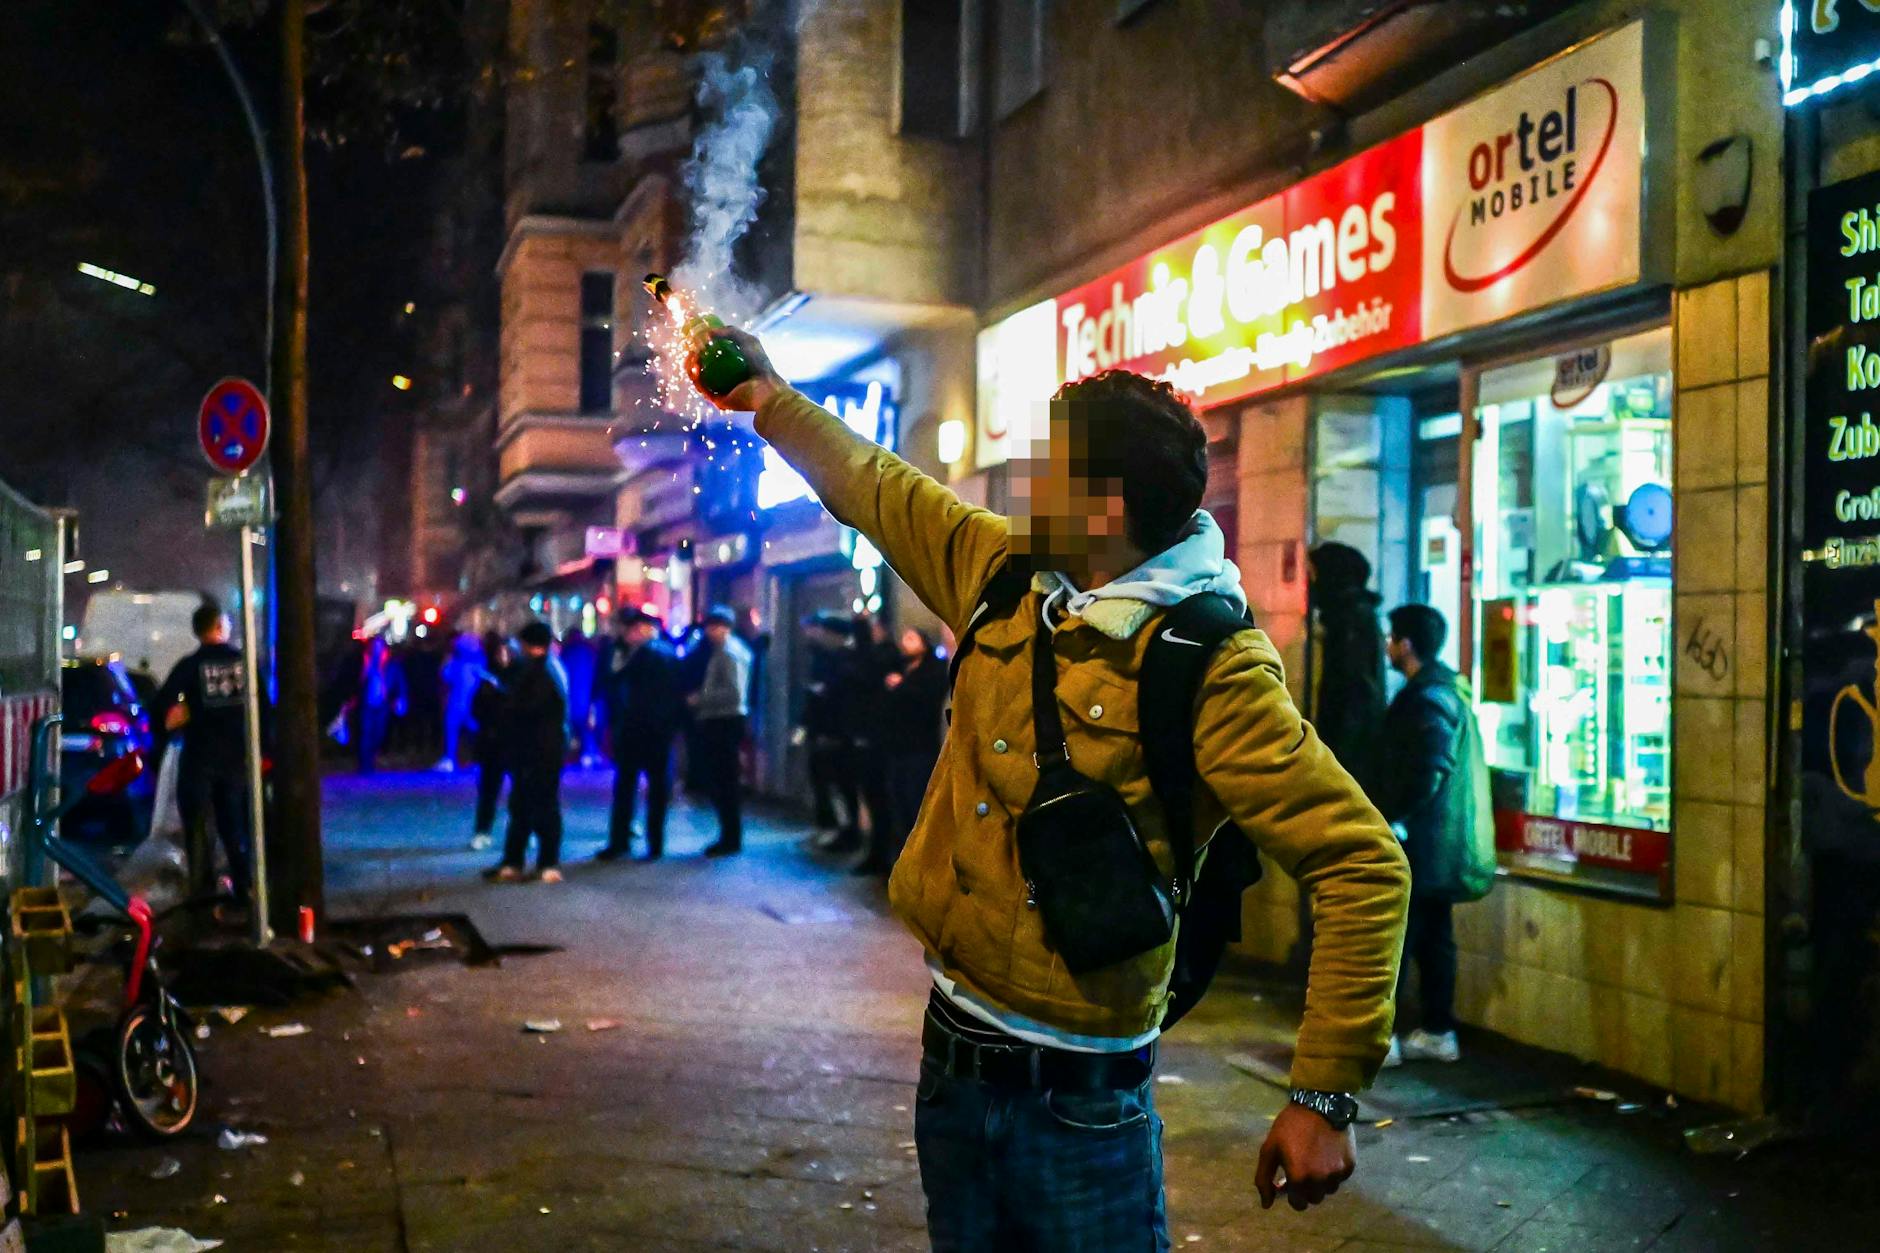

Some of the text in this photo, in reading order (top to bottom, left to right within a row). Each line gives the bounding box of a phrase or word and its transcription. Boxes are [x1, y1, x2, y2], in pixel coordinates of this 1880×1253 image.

[1469, 85, 1577, 192] ortel
[1471, 160, 1577, 226] MOBILE
[1062, 262, 1188, 383] Technic
[1226, 192, 1397, 323] Games
[1828, 412, 1880, 462] Zub
